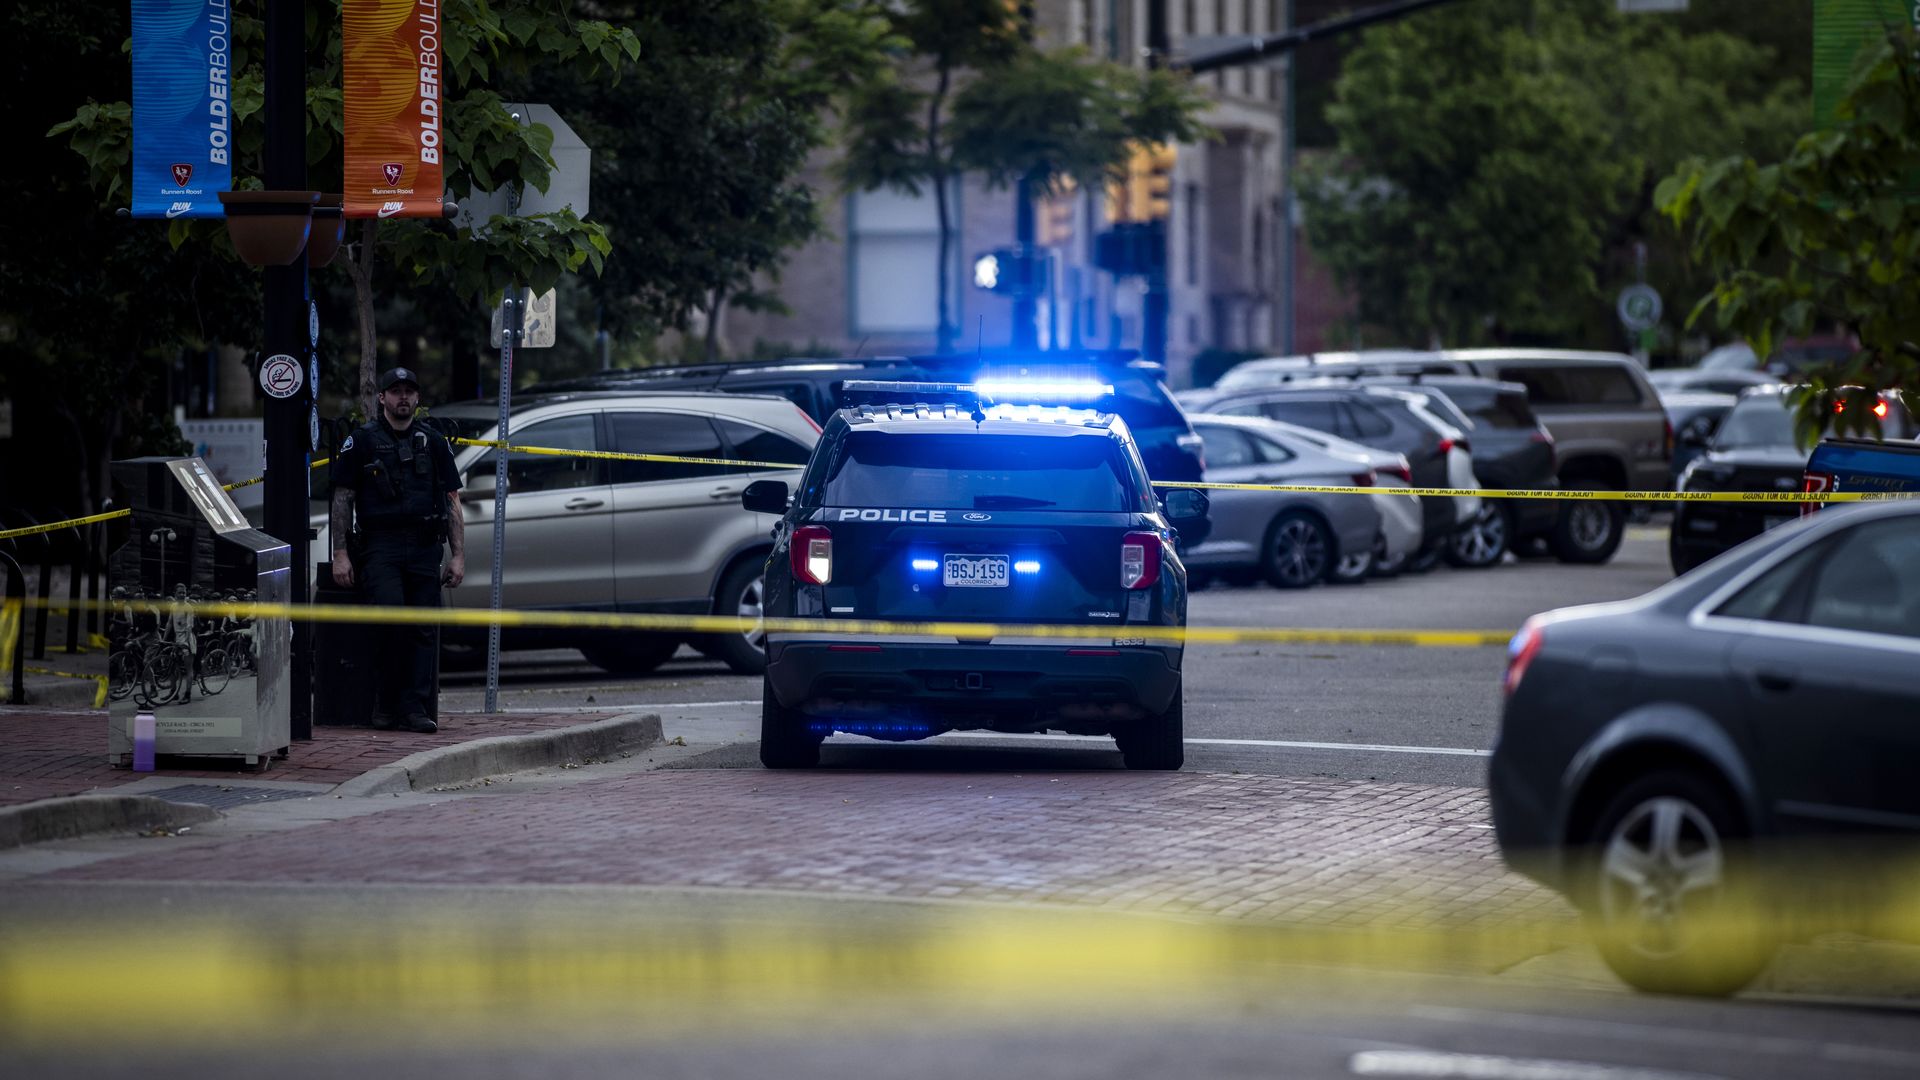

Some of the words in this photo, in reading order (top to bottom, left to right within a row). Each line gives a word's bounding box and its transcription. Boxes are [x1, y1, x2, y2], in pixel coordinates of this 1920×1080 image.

[171, 202, 192, 211] RUN
[383, 201, 403, 210] RUN
[263, 357, 277, 369] SMOKE
[287, 358, 298, 368] ZONE
[263, 383, 273, 394] ZONA
[838, 508, 947, 523] POLICE
